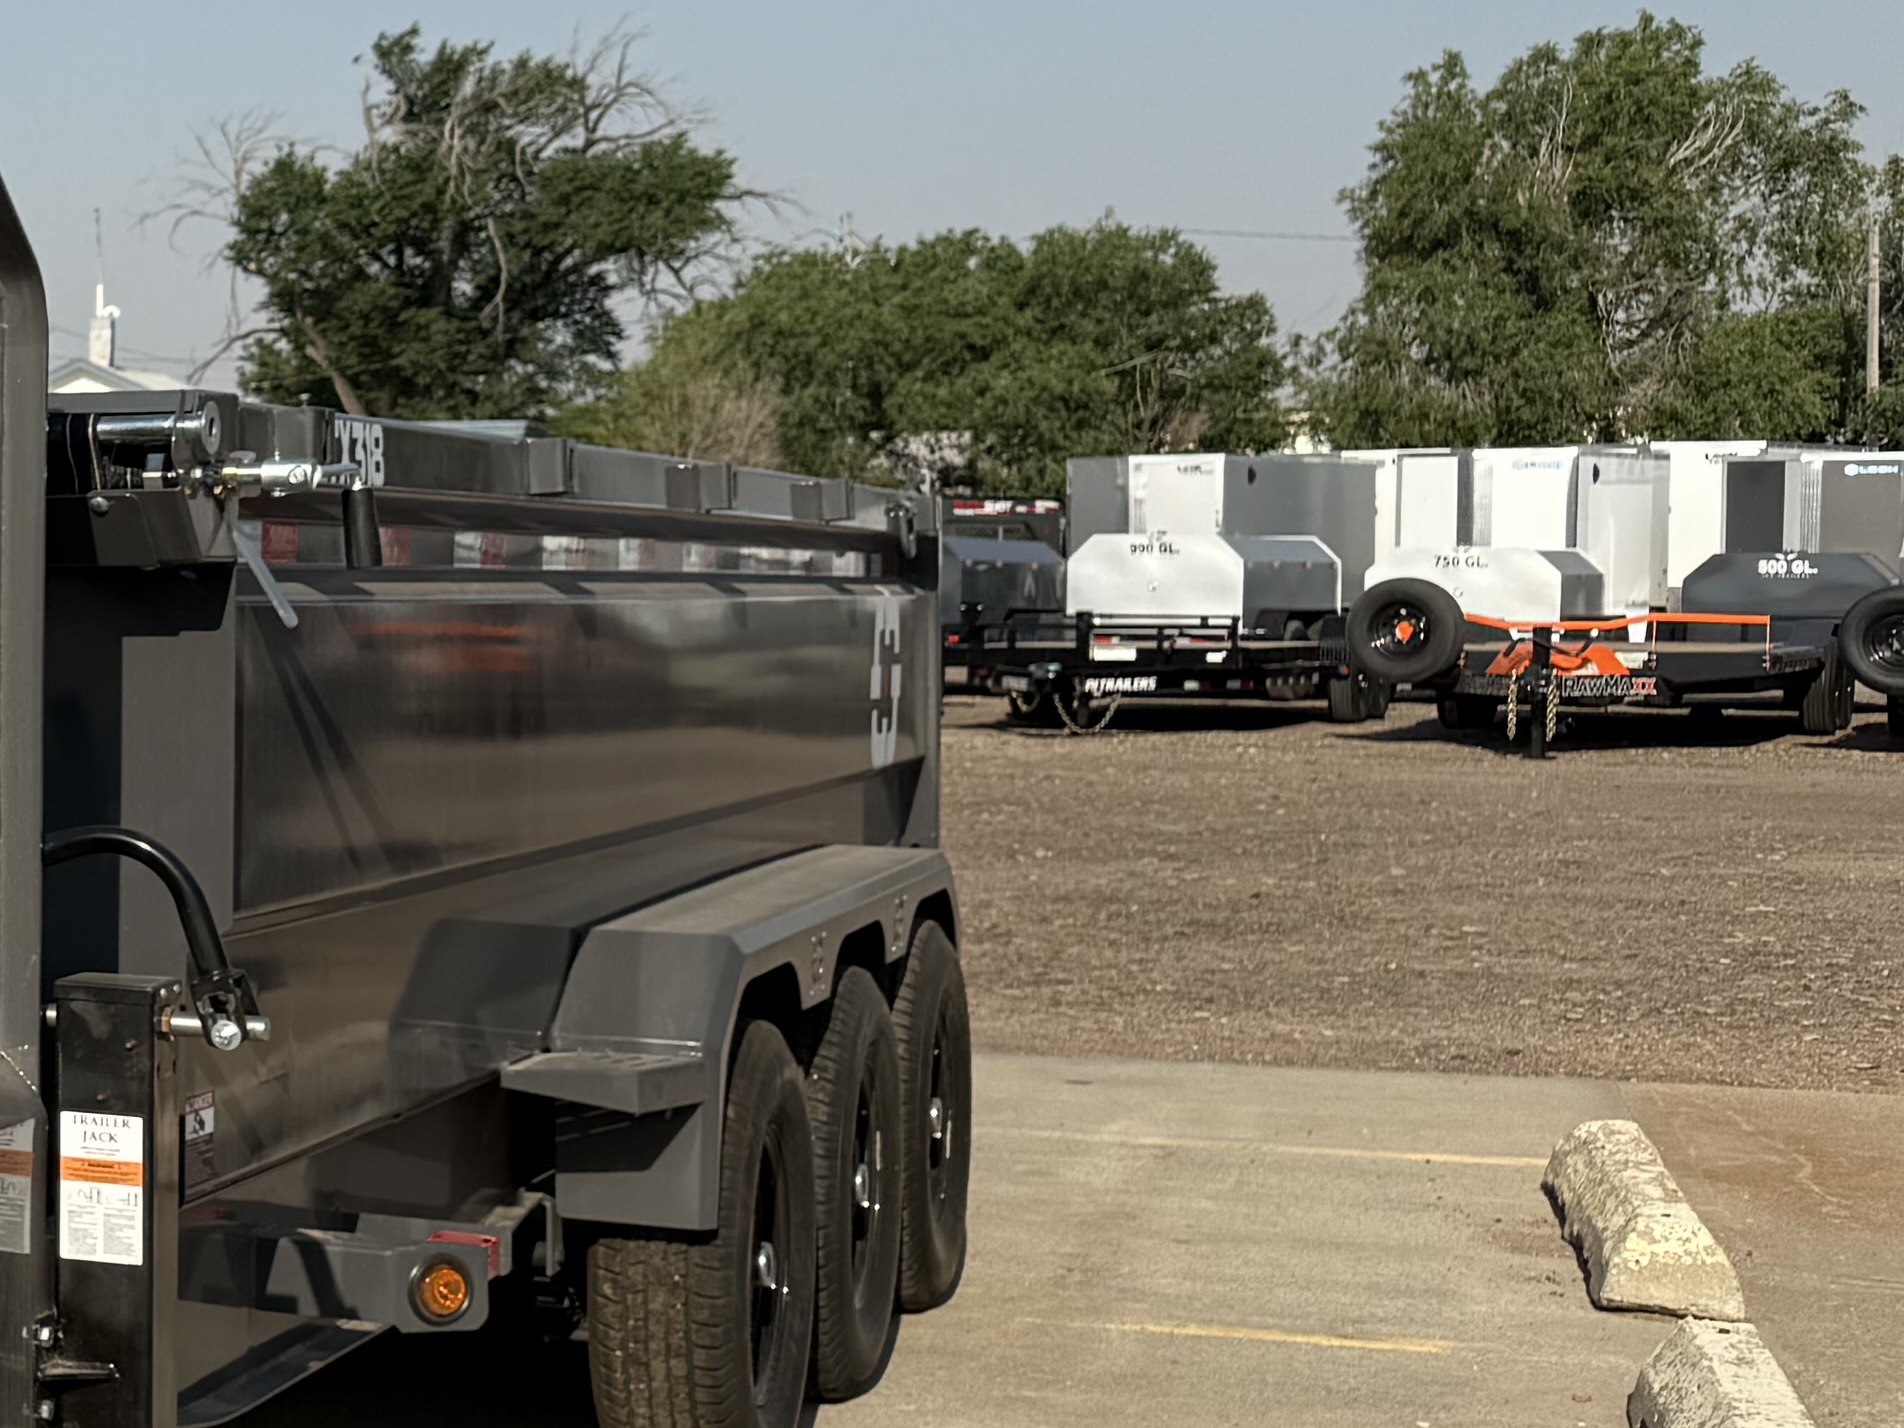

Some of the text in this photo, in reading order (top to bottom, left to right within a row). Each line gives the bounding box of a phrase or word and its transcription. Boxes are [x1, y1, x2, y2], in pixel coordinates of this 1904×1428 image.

[1434, 555, 1460, 568] 750
[1561, 674, 1658, 698] RAWMAXX
[73, 1114, 131, 1129] TRAILER
[82, 1130, 118, 1144] JACK
